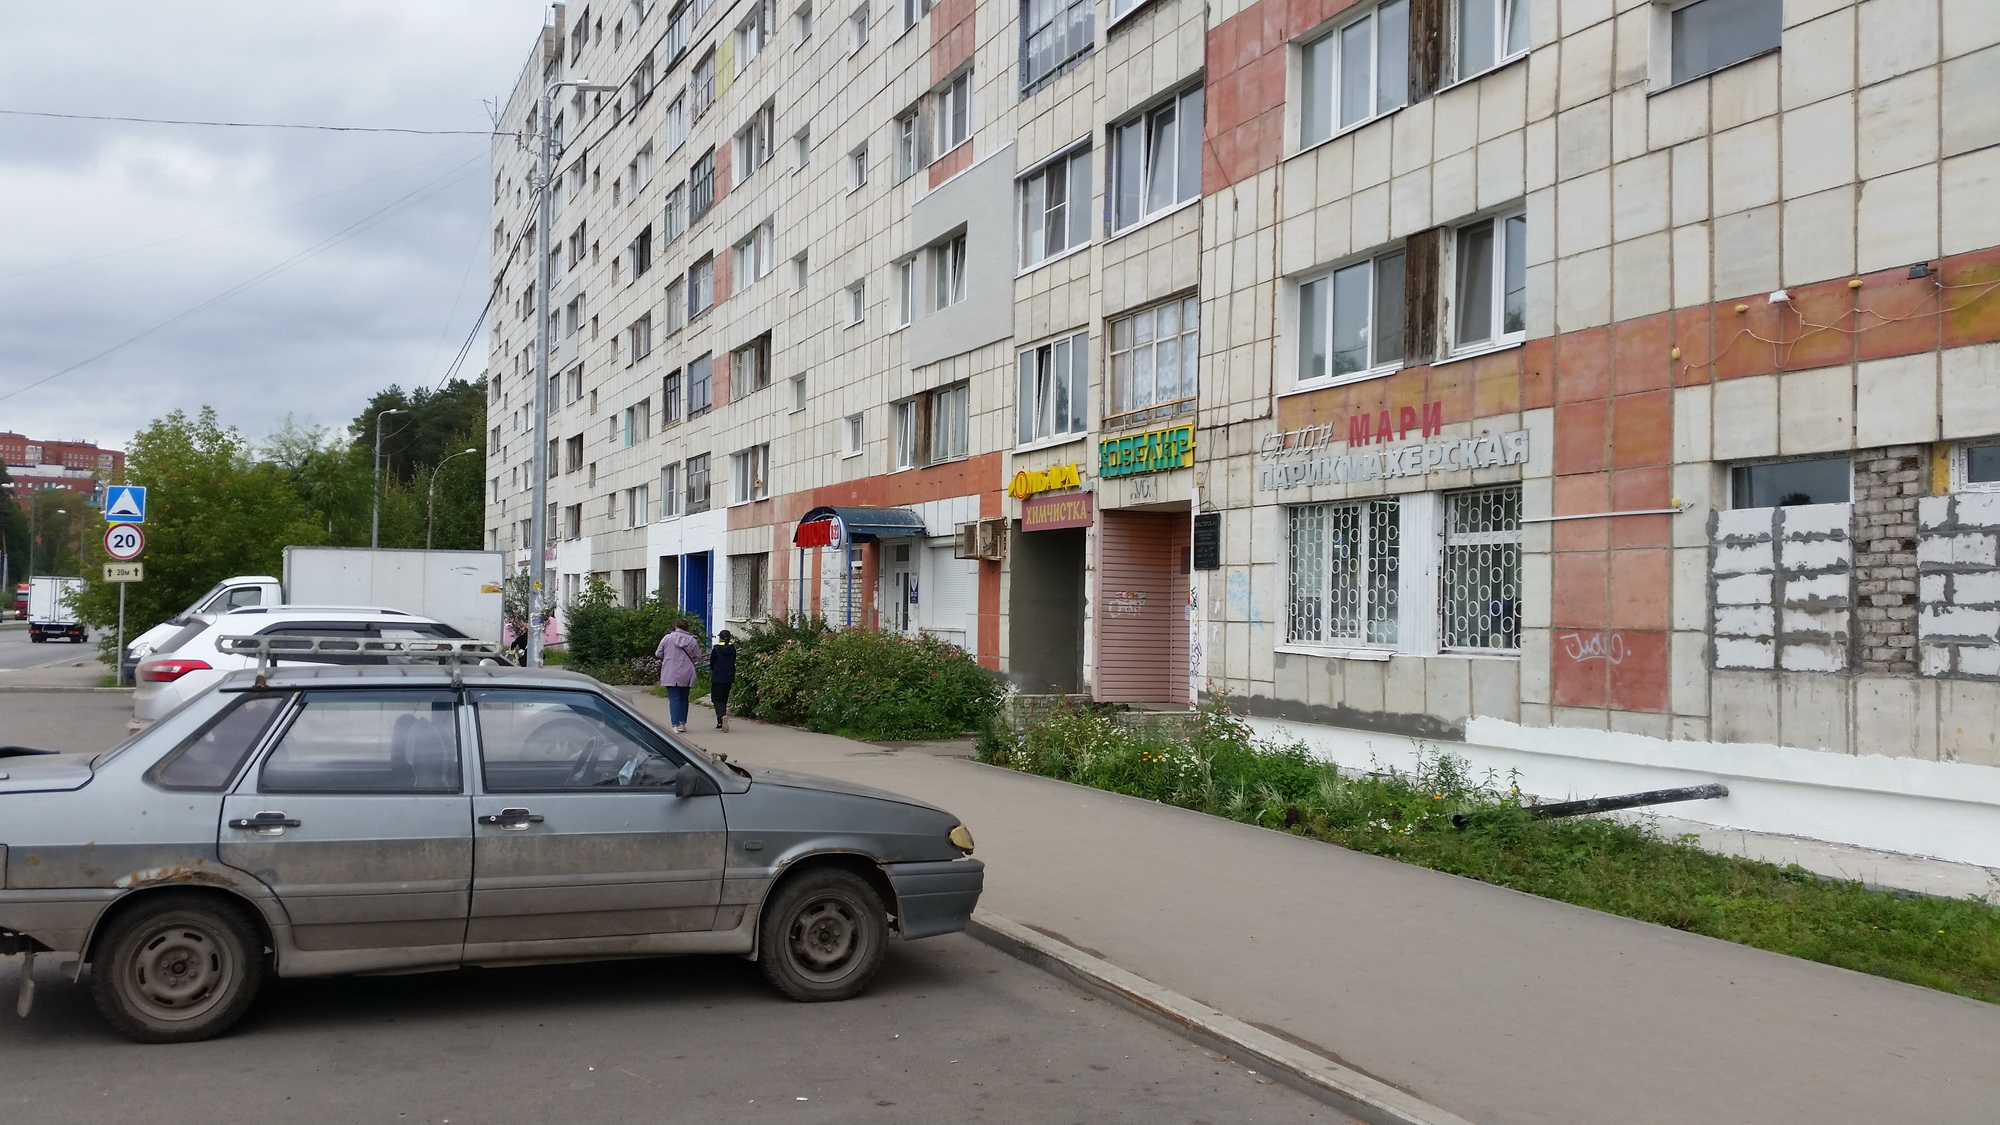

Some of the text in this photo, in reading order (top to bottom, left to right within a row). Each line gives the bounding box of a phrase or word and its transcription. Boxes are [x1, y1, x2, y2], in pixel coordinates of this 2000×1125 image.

[1261, 401, 1442, 461] САЛОН МАРИ
[1099, 427, 1190, 478] ЮВЕЛИР
[1258, 429, 1530, 492] ПАРИКМАХЕРСКАЯ
[1025, 500, 1088, 525] ХИМЧИСТКА
[114, 534, 135, 548] 20
[117, 568, 130, 576] 20м
